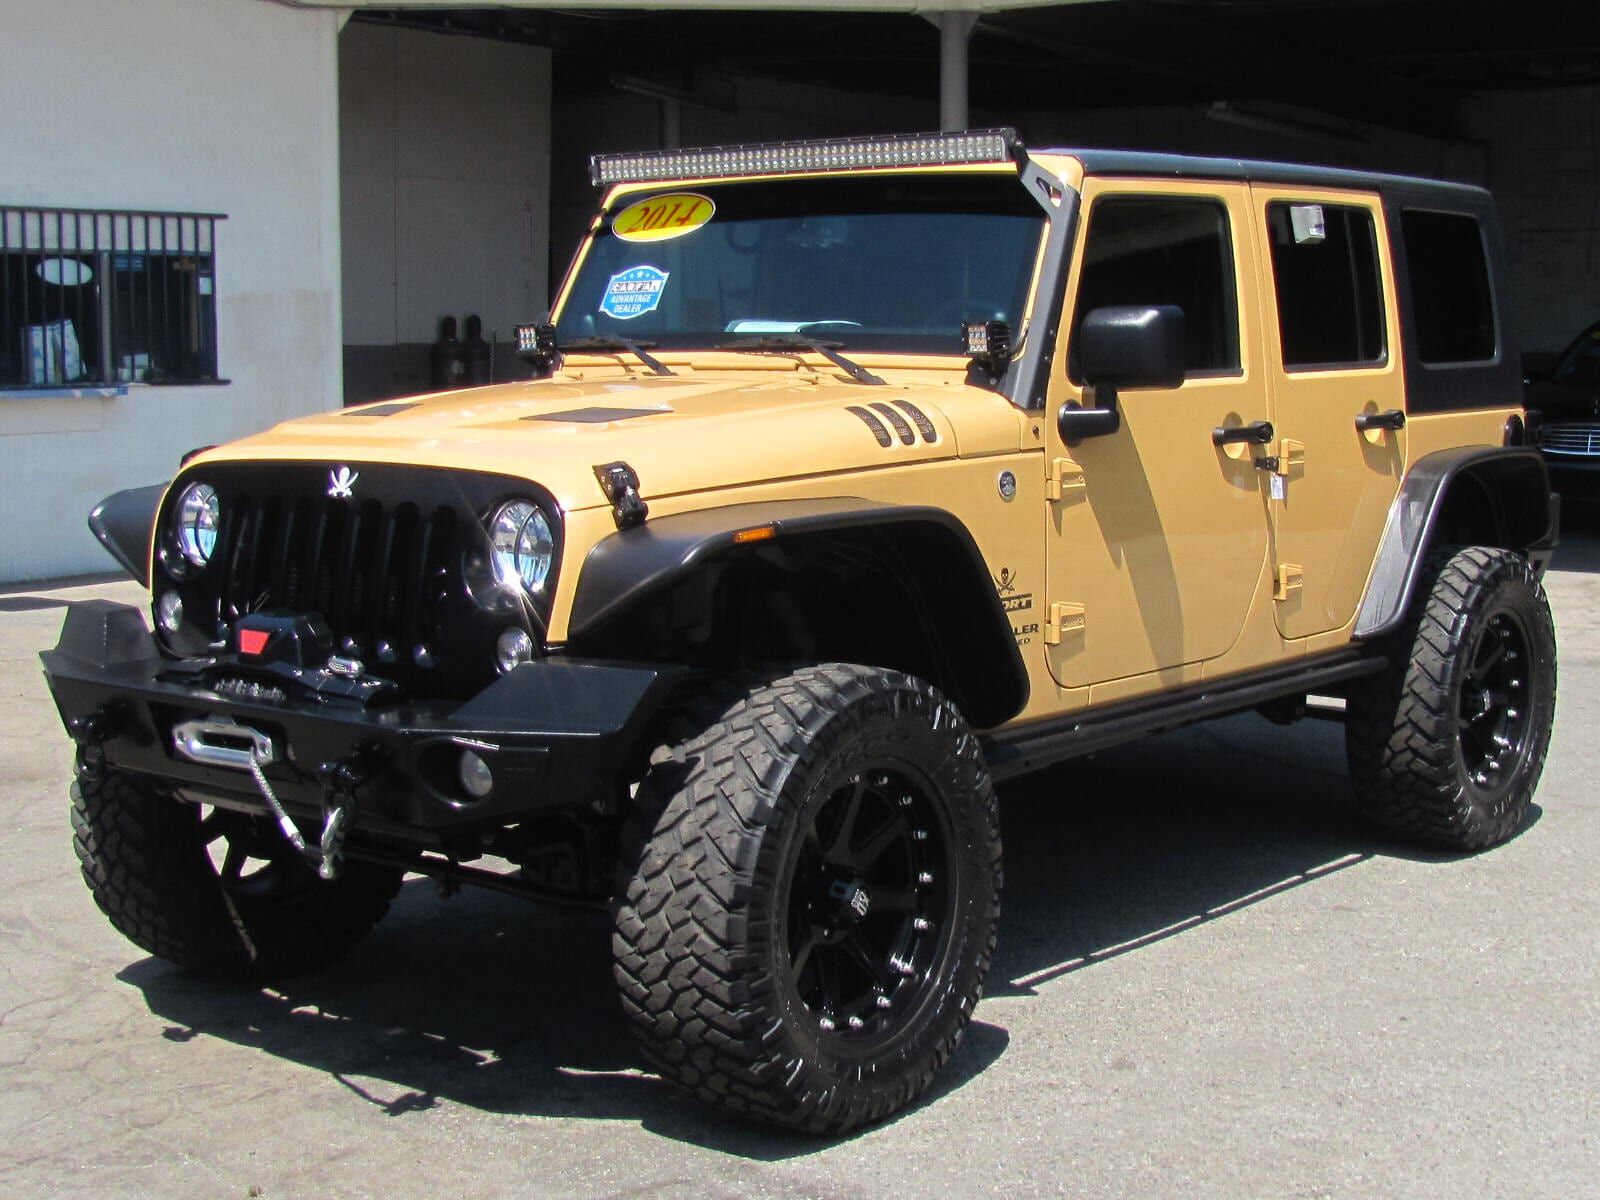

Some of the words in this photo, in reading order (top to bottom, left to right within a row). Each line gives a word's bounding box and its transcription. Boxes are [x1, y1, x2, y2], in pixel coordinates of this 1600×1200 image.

[624, 199, 705, 233] 2014
[610, 294, 652, 304] ADVANTAGE
[613, 304, 642, 313] DEALER
